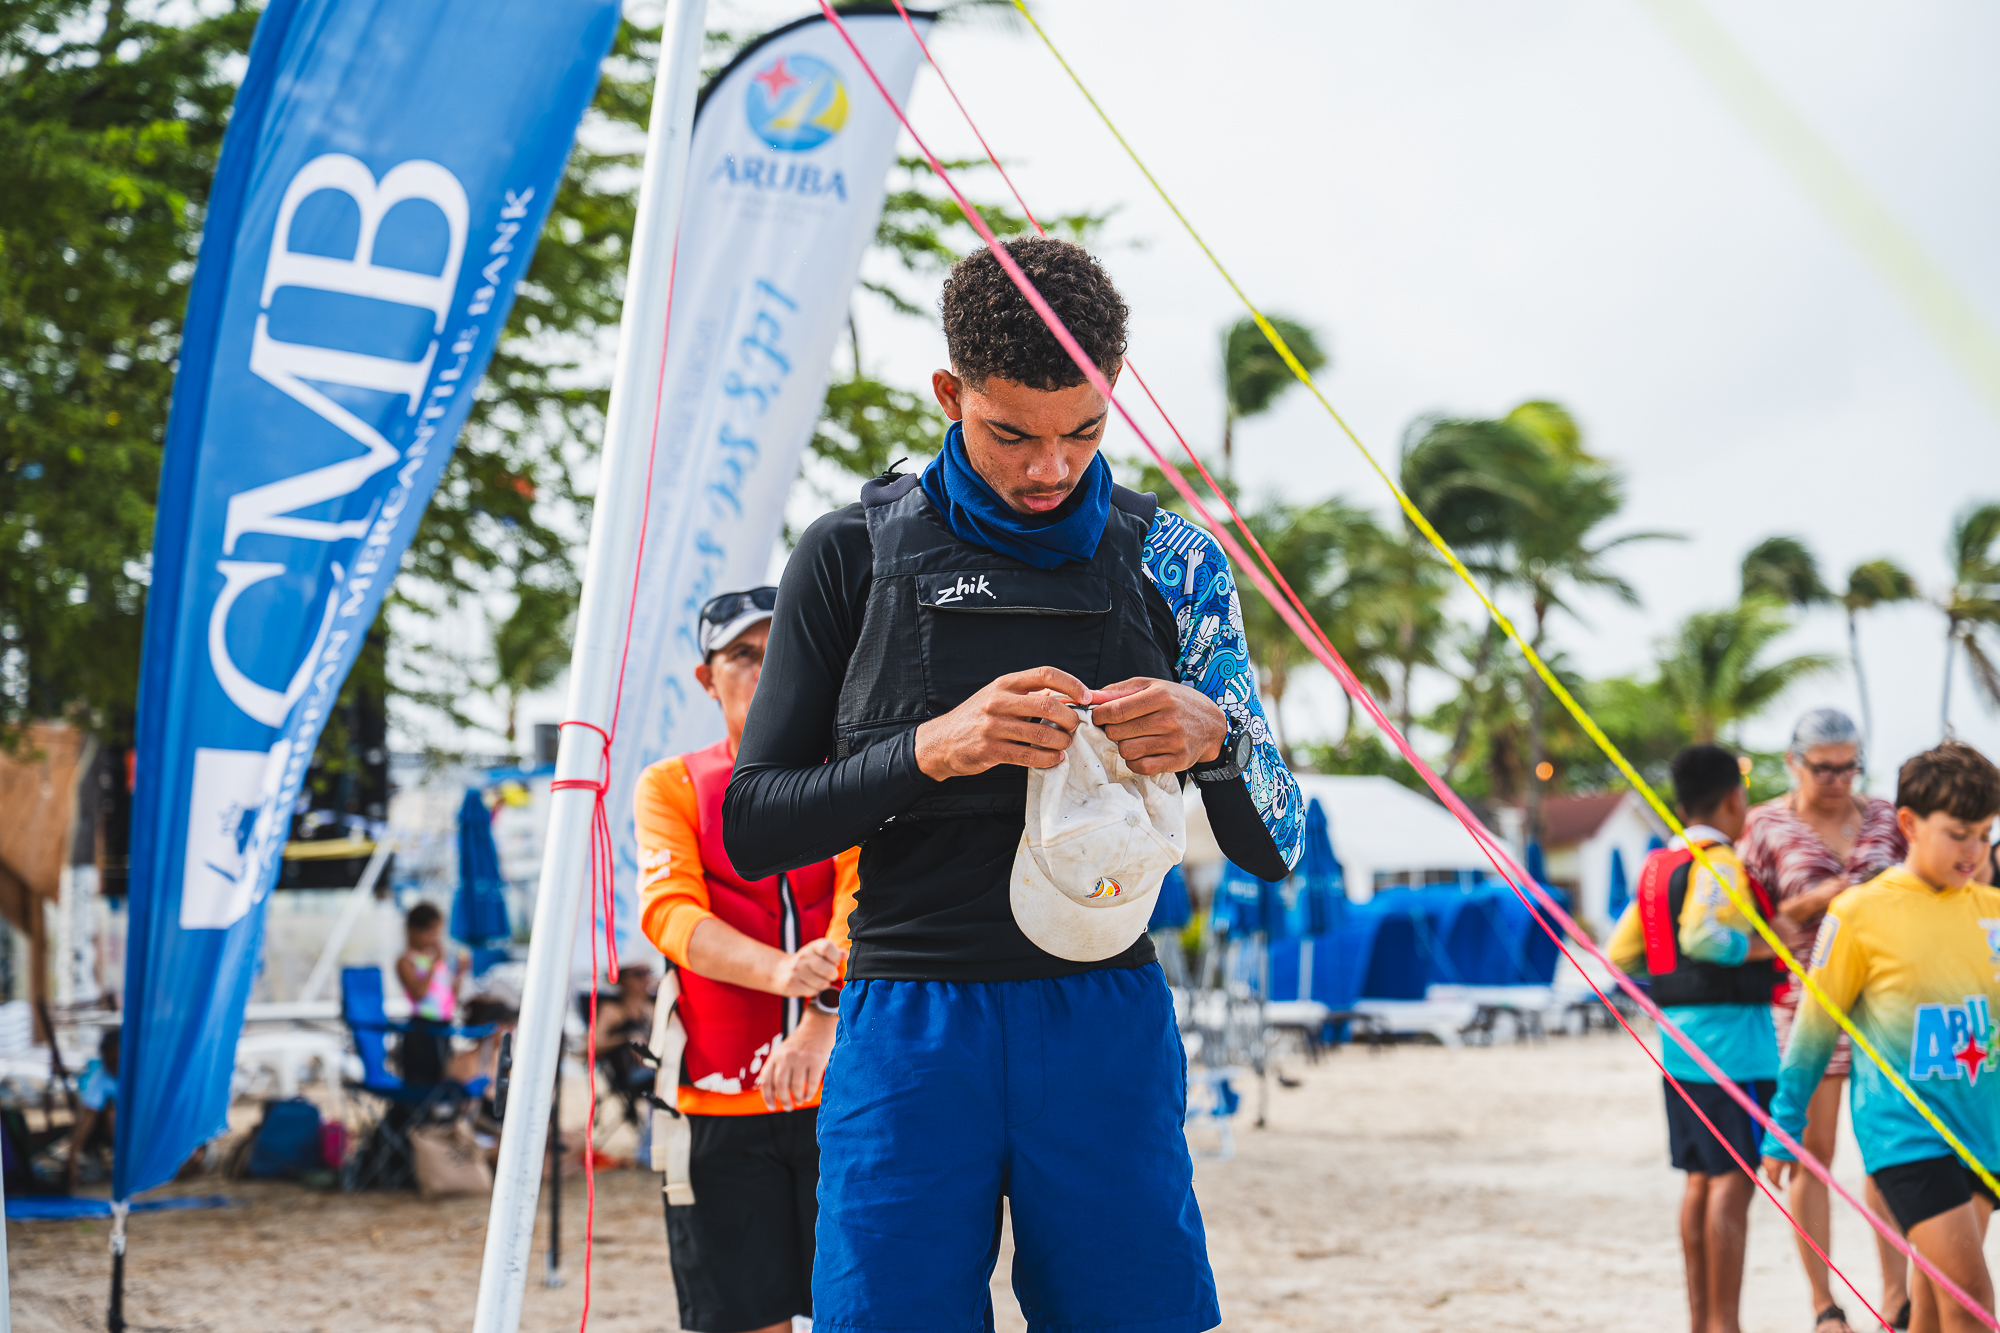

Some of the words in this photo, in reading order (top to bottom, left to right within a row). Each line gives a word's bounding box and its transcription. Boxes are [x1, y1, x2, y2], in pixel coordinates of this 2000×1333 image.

[708, 155, 848, 203] ARUBA
[208, 153, 470, 729] CMB
[339, 325, 480, 618] MERCANTILE
[467, 186, 535, 316] BANK
